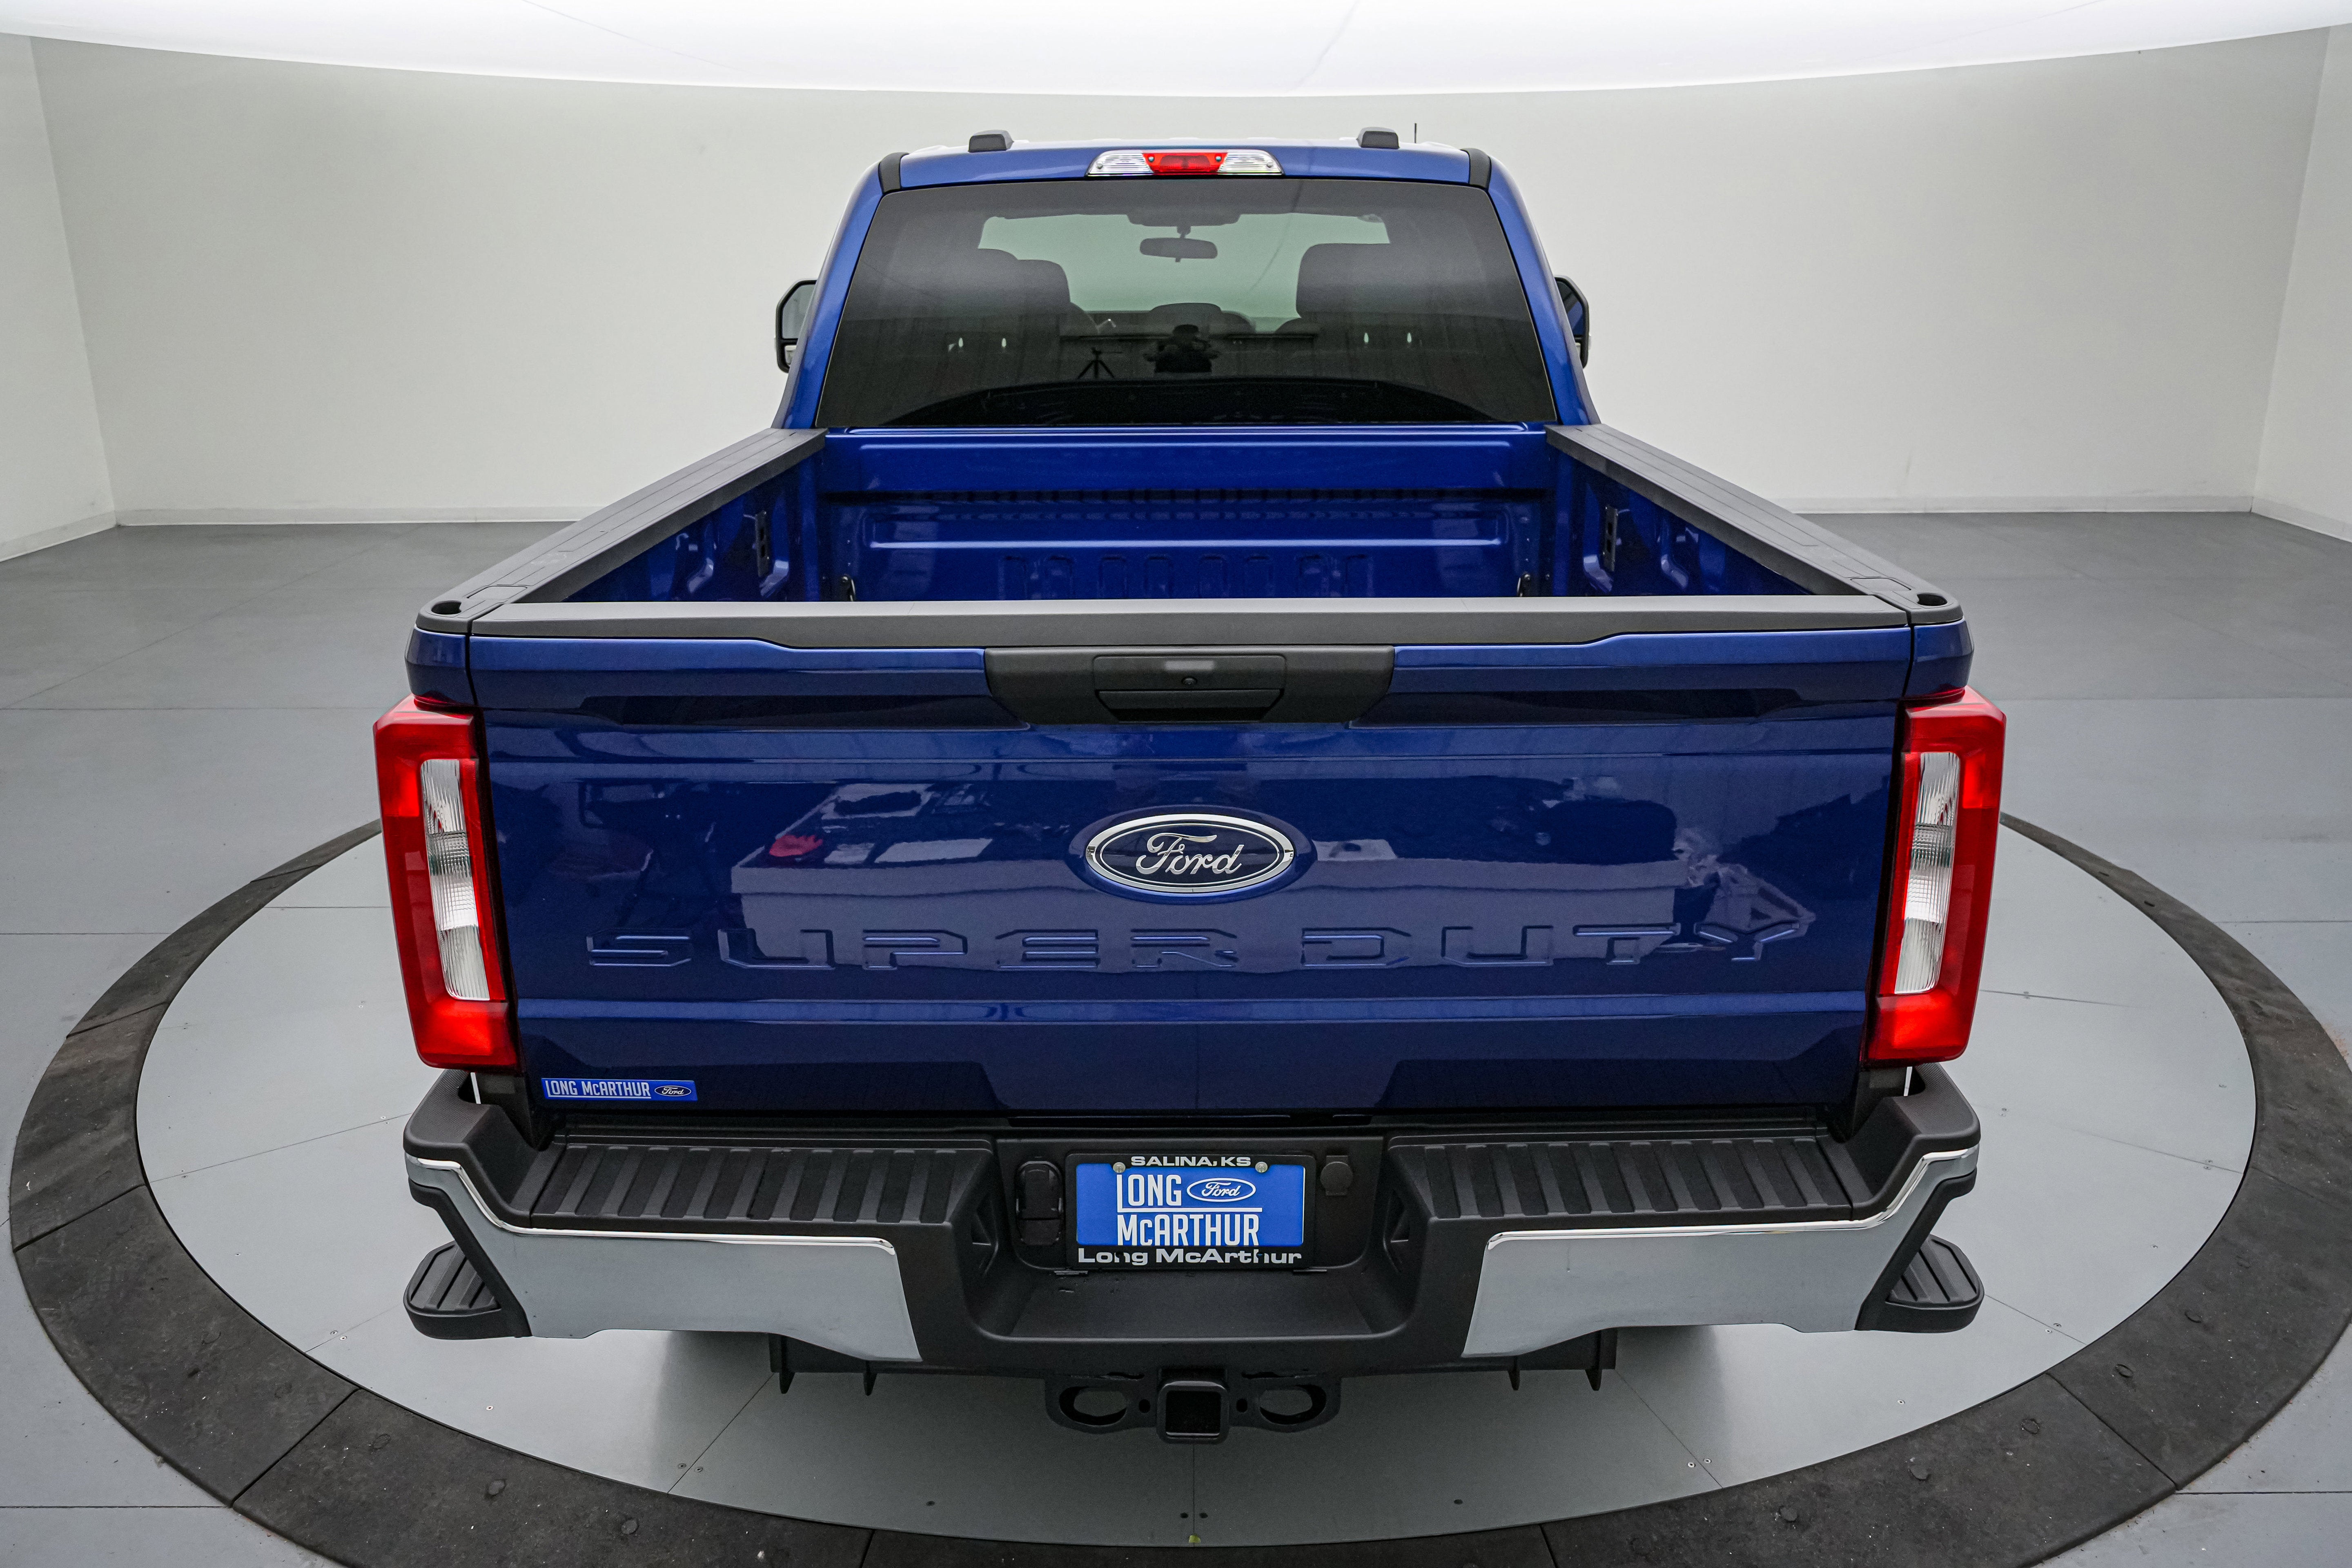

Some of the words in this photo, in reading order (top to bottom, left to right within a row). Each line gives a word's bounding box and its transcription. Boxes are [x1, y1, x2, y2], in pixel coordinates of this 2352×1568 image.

[1136, 832, 1244, 875] Ford
[586, 928, 1238, 971] SUPER
[1302, 923, 1800, 967] DUTY
[545, 1080, 578, 1097] LONG
[581, 1081, 651, 1096] McARTHUR
[661, 1086, 684, 1095] Ford
[1131, 1156, 1217, 1167] SALINA,
[1221, 1156, 1251, 1167] KS
[1116, 1174, 1182, 1212] LONG
[1201, 1182, 1241, 1197] Ford
[1117, 1214, 1259, 1246] McARTHUR
[1078, 1248, 1148, 1265] Long
[1156, 1248, 1301, 1264] McArthur
